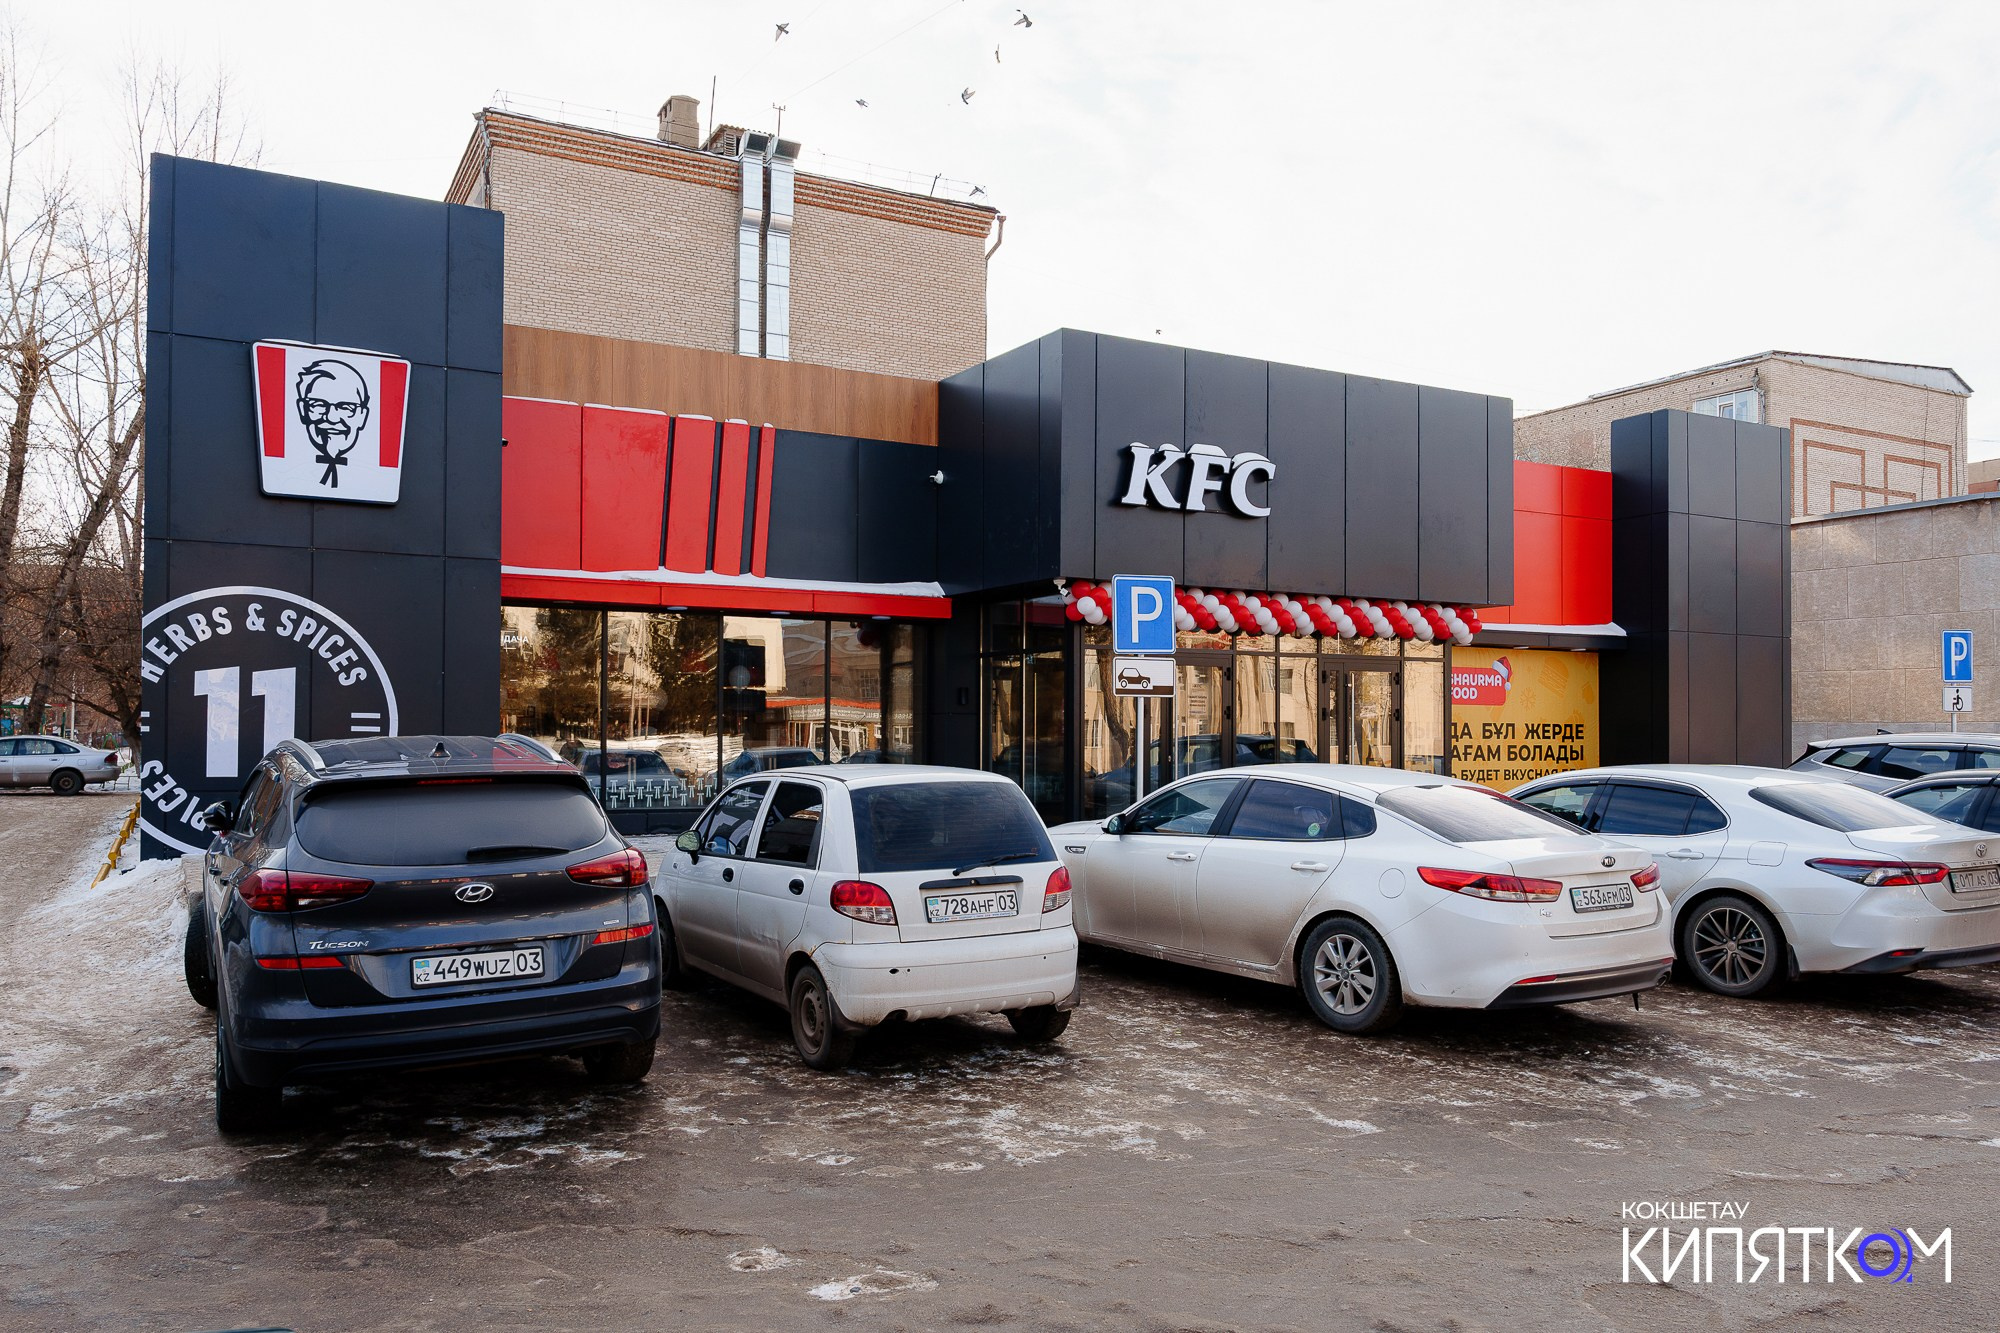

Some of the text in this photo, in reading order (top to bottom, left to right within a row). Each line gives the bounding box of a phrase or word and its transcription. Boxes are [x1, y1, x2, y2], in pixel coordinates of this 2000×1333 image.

[1121, 445, 1277, 518] KFC
[1130, 586, 1163, 643] P
[141, 602, 368, 687] HERBS & SPICES
[503, 635, 529, 644] ДАЧА
[1950, 636, 1968, 676] P
[1451, 673, 1503, 687] HAURMA
[1451, 687, 1479, 700] OOD
[193, 665, 297, 778] 11
[1524, 723, 1585, 743] ЖЕРДЕ
[1506, 744, 1584, 764] БОЛАДЫ
[1460, 769, 1501, 783] БУДЕТ
[929, 909, 940, 917] KZ
[308, 939, 370, 950] TUCSON
[415, 972, 430, 983] KZ
